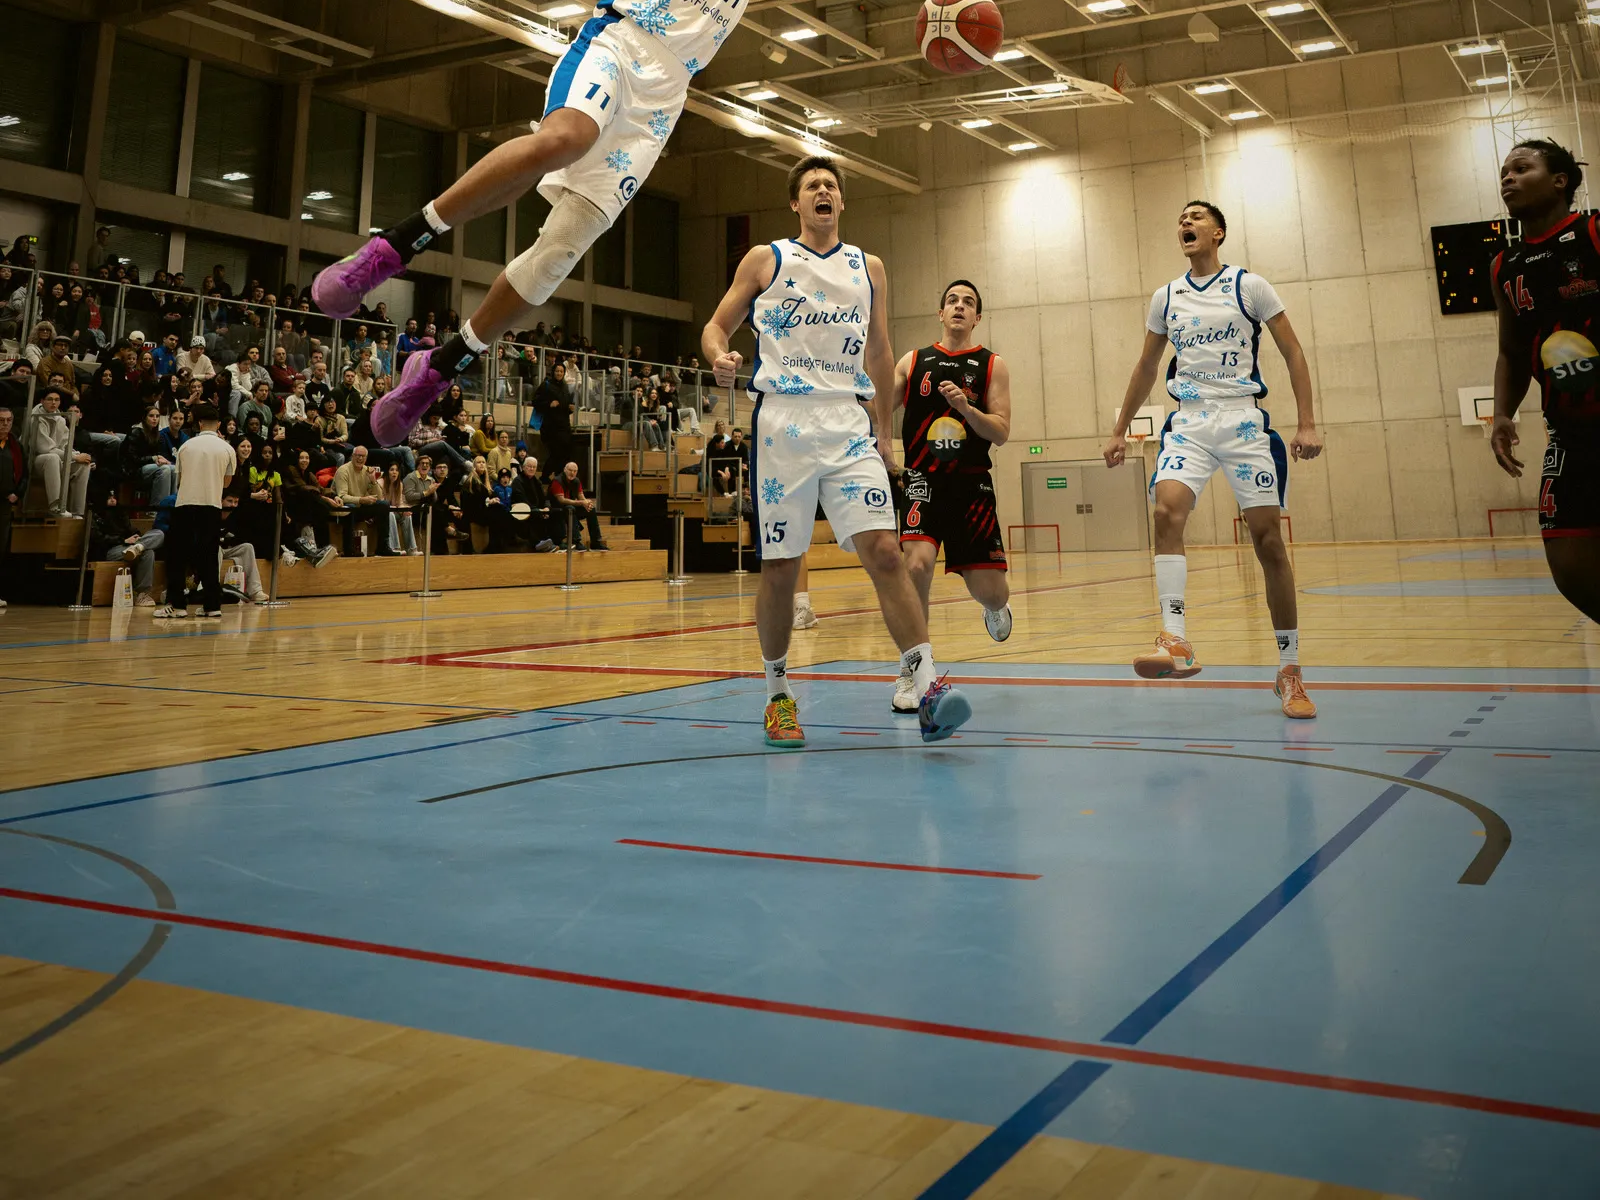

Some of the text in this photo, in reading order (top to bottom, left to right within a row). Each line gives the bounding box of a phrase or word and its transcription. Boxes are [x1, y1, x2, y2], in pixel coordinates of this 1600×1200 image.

[583, 81, 611, 112] 11
[1524, 252, 1547, 264] CRAFT
[1503, 274, 1535, 316] 14
[780, 296, 863, 329] Zurich
[841, 336, 863, 356] 15
[1173, 321, 1240, 352] Zurich
[1220, 351, 1240, 367] 13
[1552, 358, 1594, 380] SIG
[919, 371, 932, 397] 6
[934, 438, 961, 450] SIG
[1160, 455, 1187, 471] 13
[906, 501, 922, 528] 6
[765, 521, 787, 545] 15
